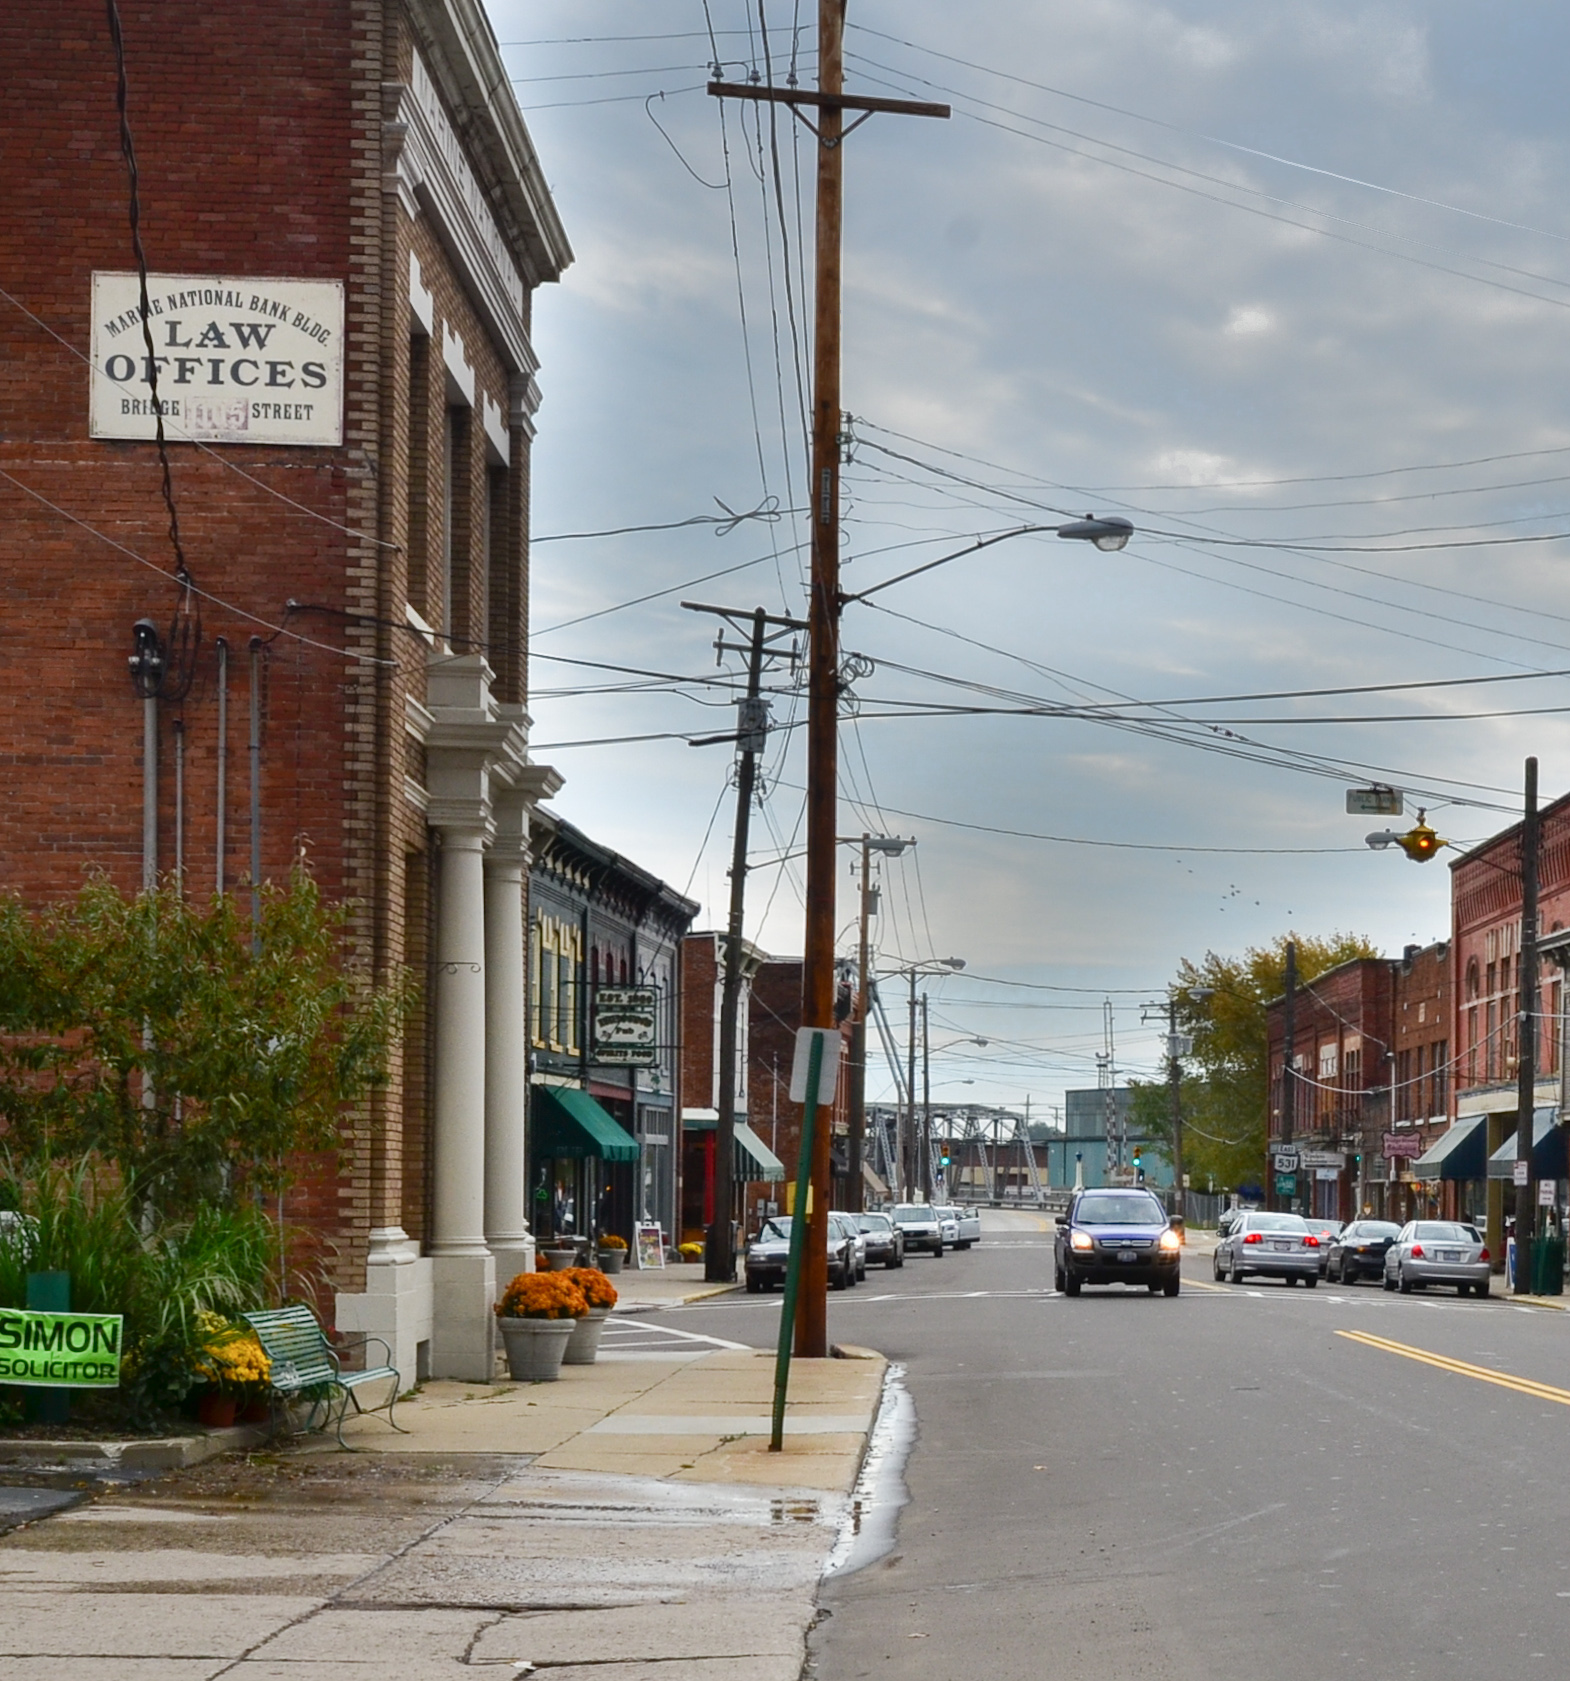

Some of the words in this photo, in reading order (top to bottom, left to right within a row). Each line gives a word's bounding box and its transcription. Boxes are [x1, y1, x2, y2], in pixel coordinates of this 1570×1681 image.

[166, 289, 244, 311] NATIONAL
[249, 294, 292, 322] BANK
[291, 312, 332, 348] BLDG.
[164, 320, 277, 351] LAW
[104, 354, 328, 389] OFFICES
[251, 402, 315, 421] STREET
[1278, 1158, 1295, 1169] 531
[0, 1318, 118, 1353] SIMON
[0, 1358, 117, 1379] SOLICITOR
